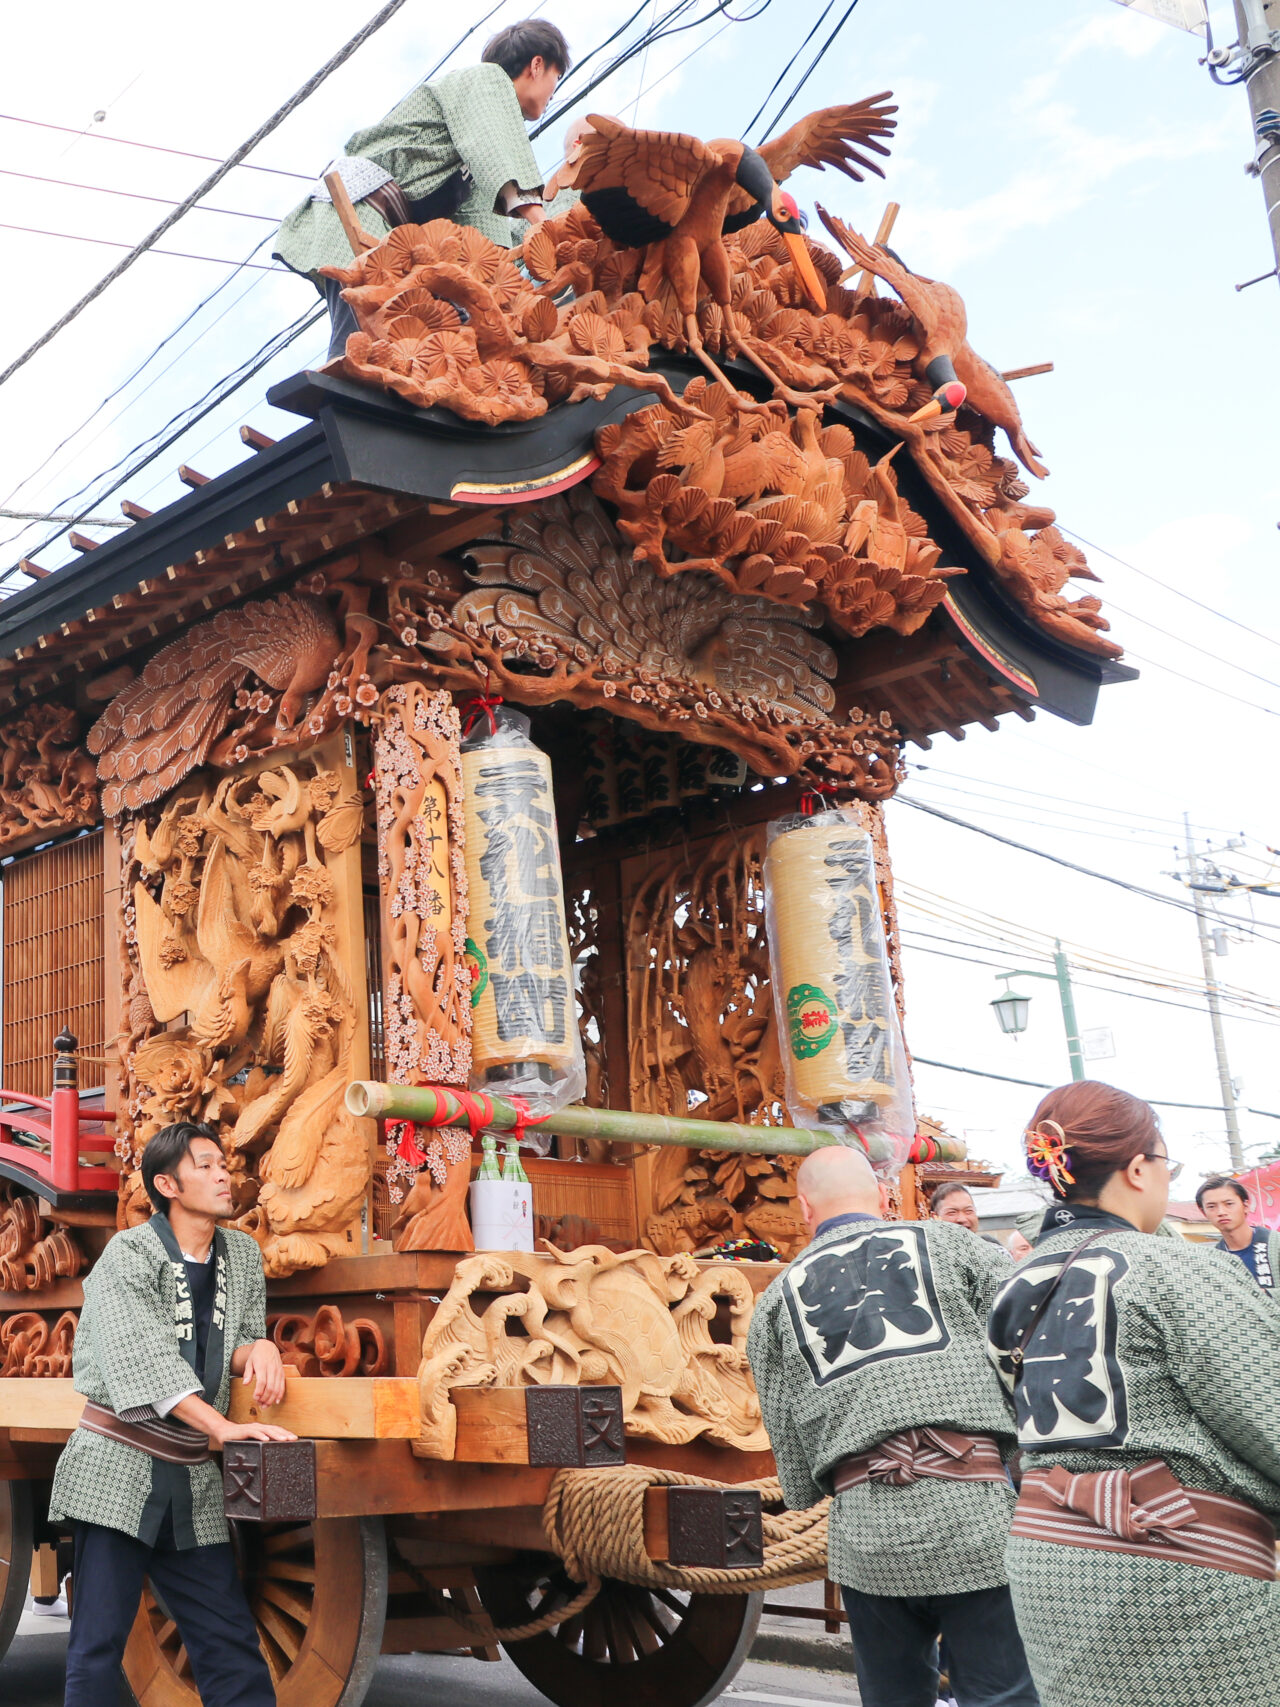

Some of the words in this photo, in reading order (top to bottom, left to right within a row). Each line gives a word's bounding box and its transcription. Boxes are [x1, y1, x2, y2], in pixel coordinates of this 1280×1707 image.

[423, 795, 446, 916] 第十八番
[474, 758, 567, 1043] 文化橋町
[583, 1399, 620, 1451] 文
[226, 1452, 261, 1505] 文
[725, 1500, 760, 1551] 文
